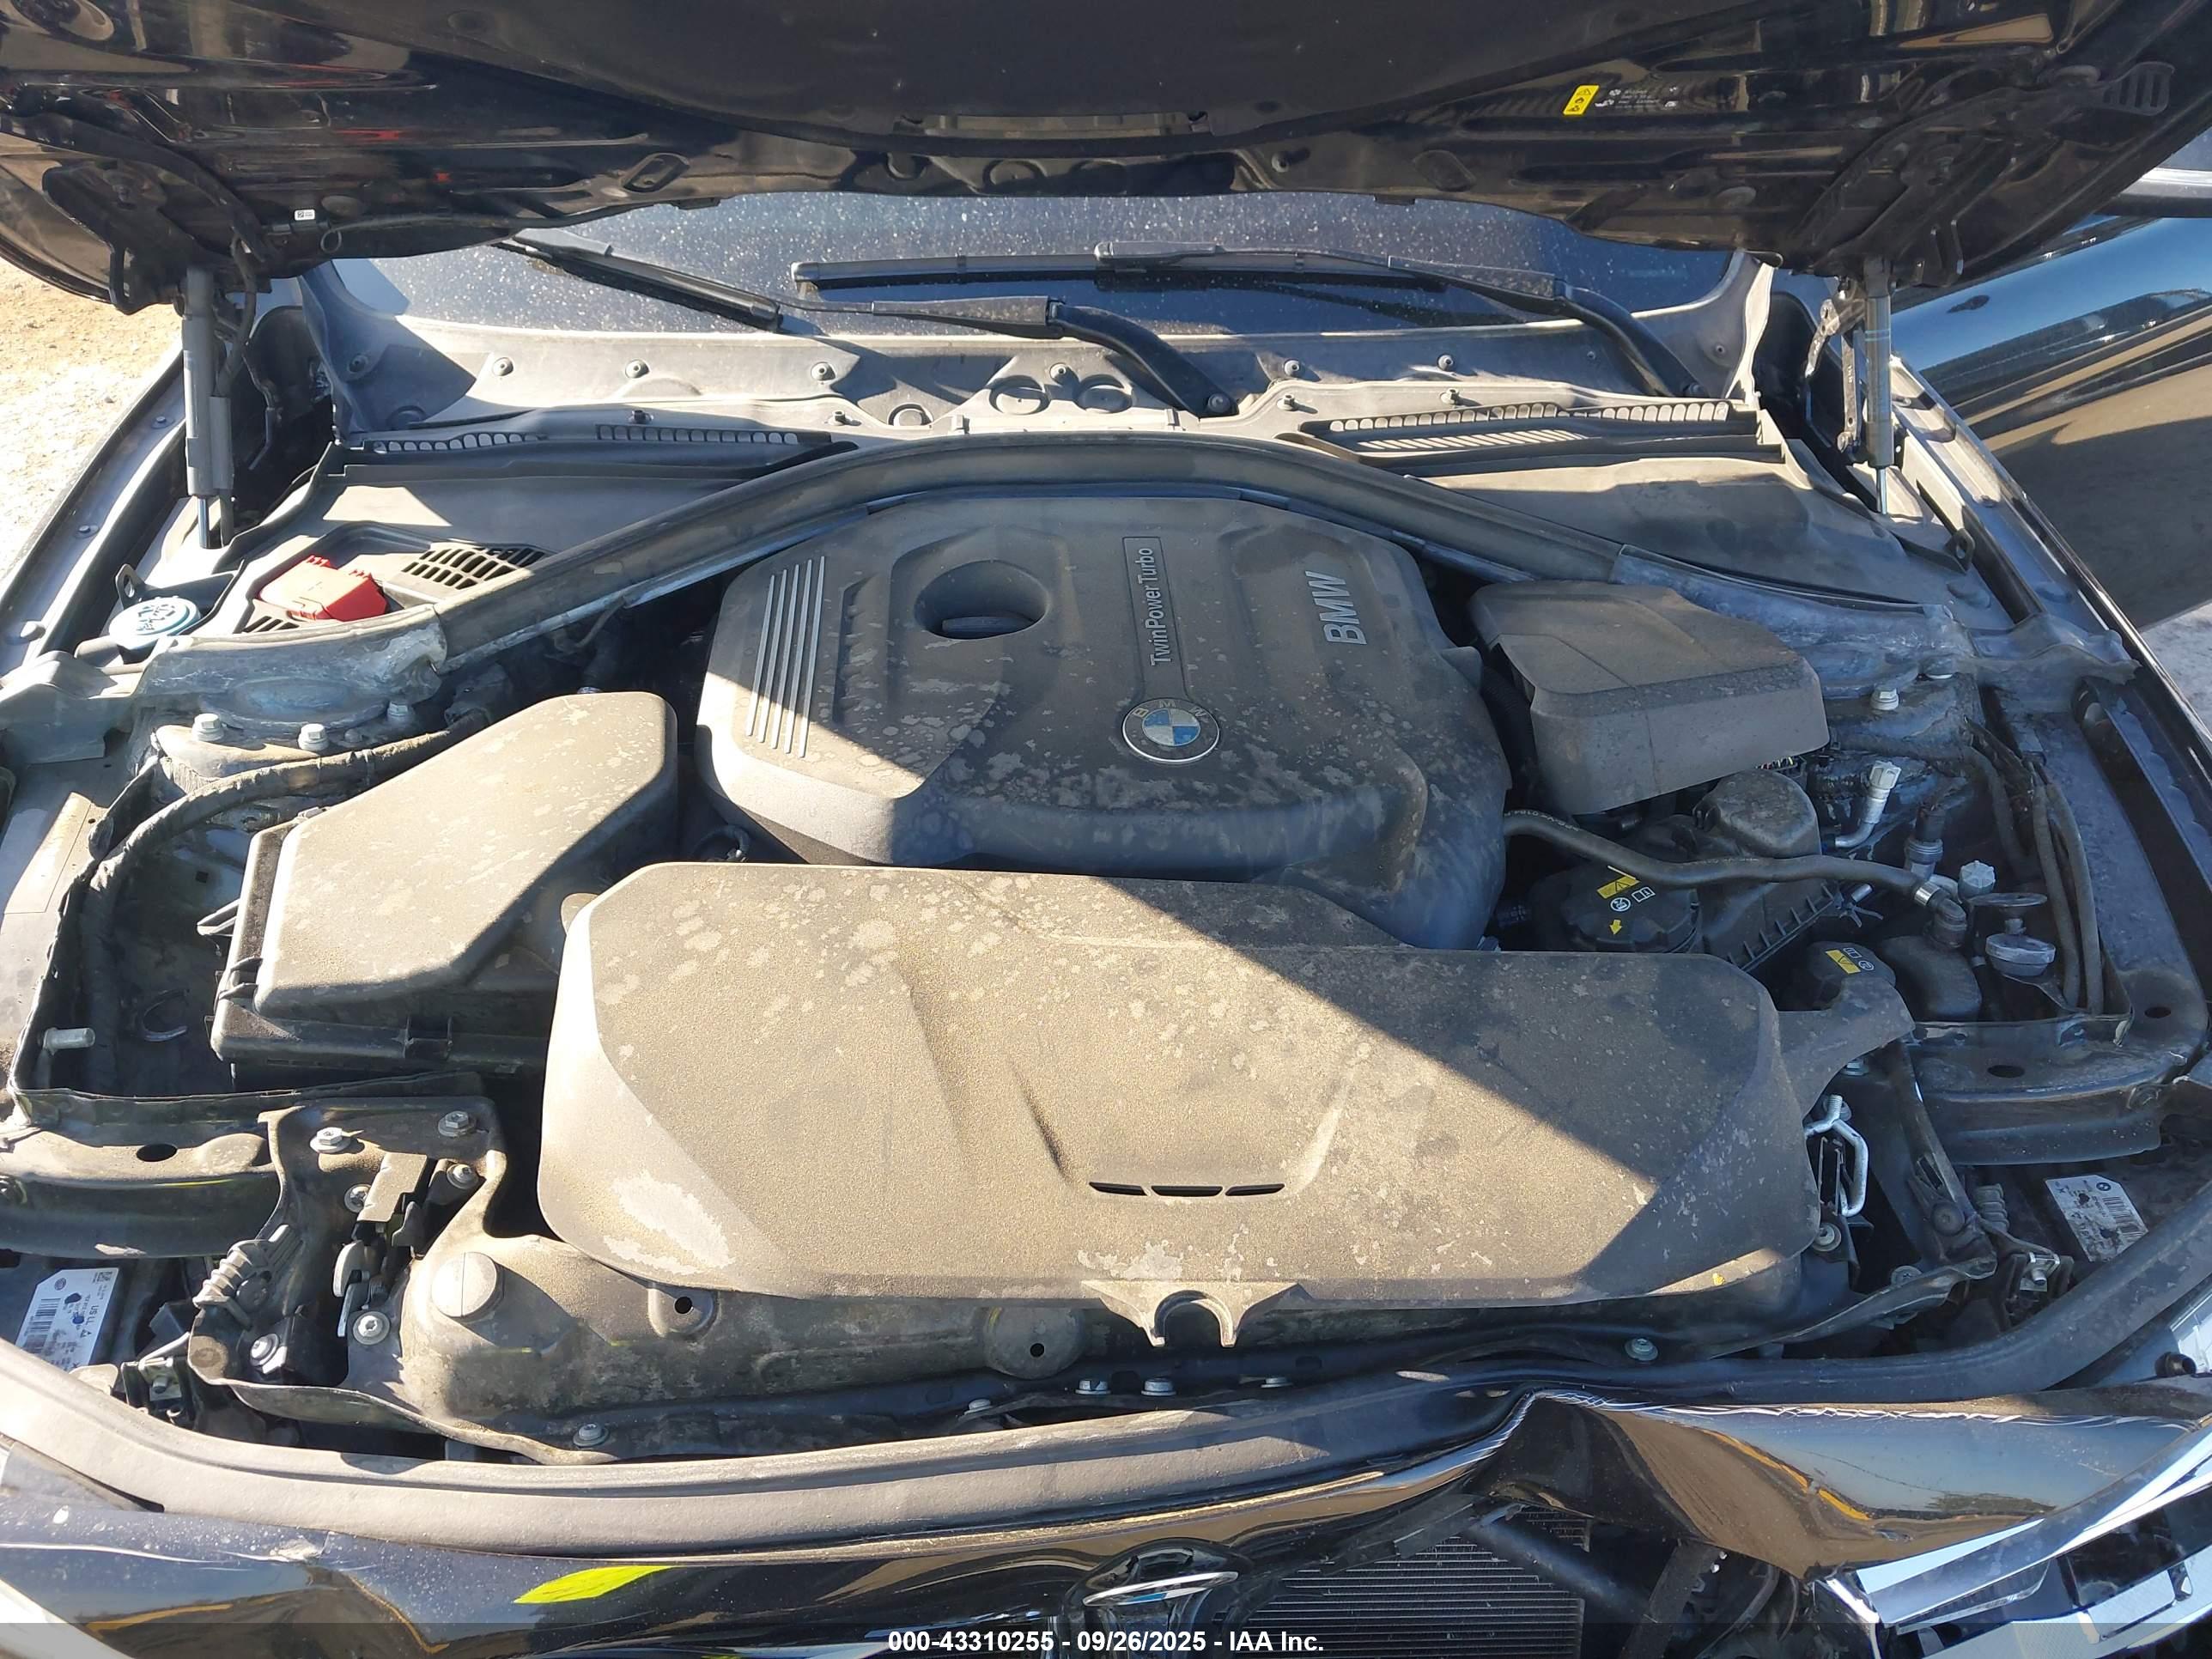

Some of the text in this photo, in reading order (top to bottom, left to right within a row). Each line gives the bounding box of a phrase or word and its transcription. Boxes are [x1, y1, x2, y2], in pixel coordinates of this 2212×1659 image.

[1134, 547, 1171, 667] TwinPower Turbo
[1305, 570, 1367, 644] BMW
